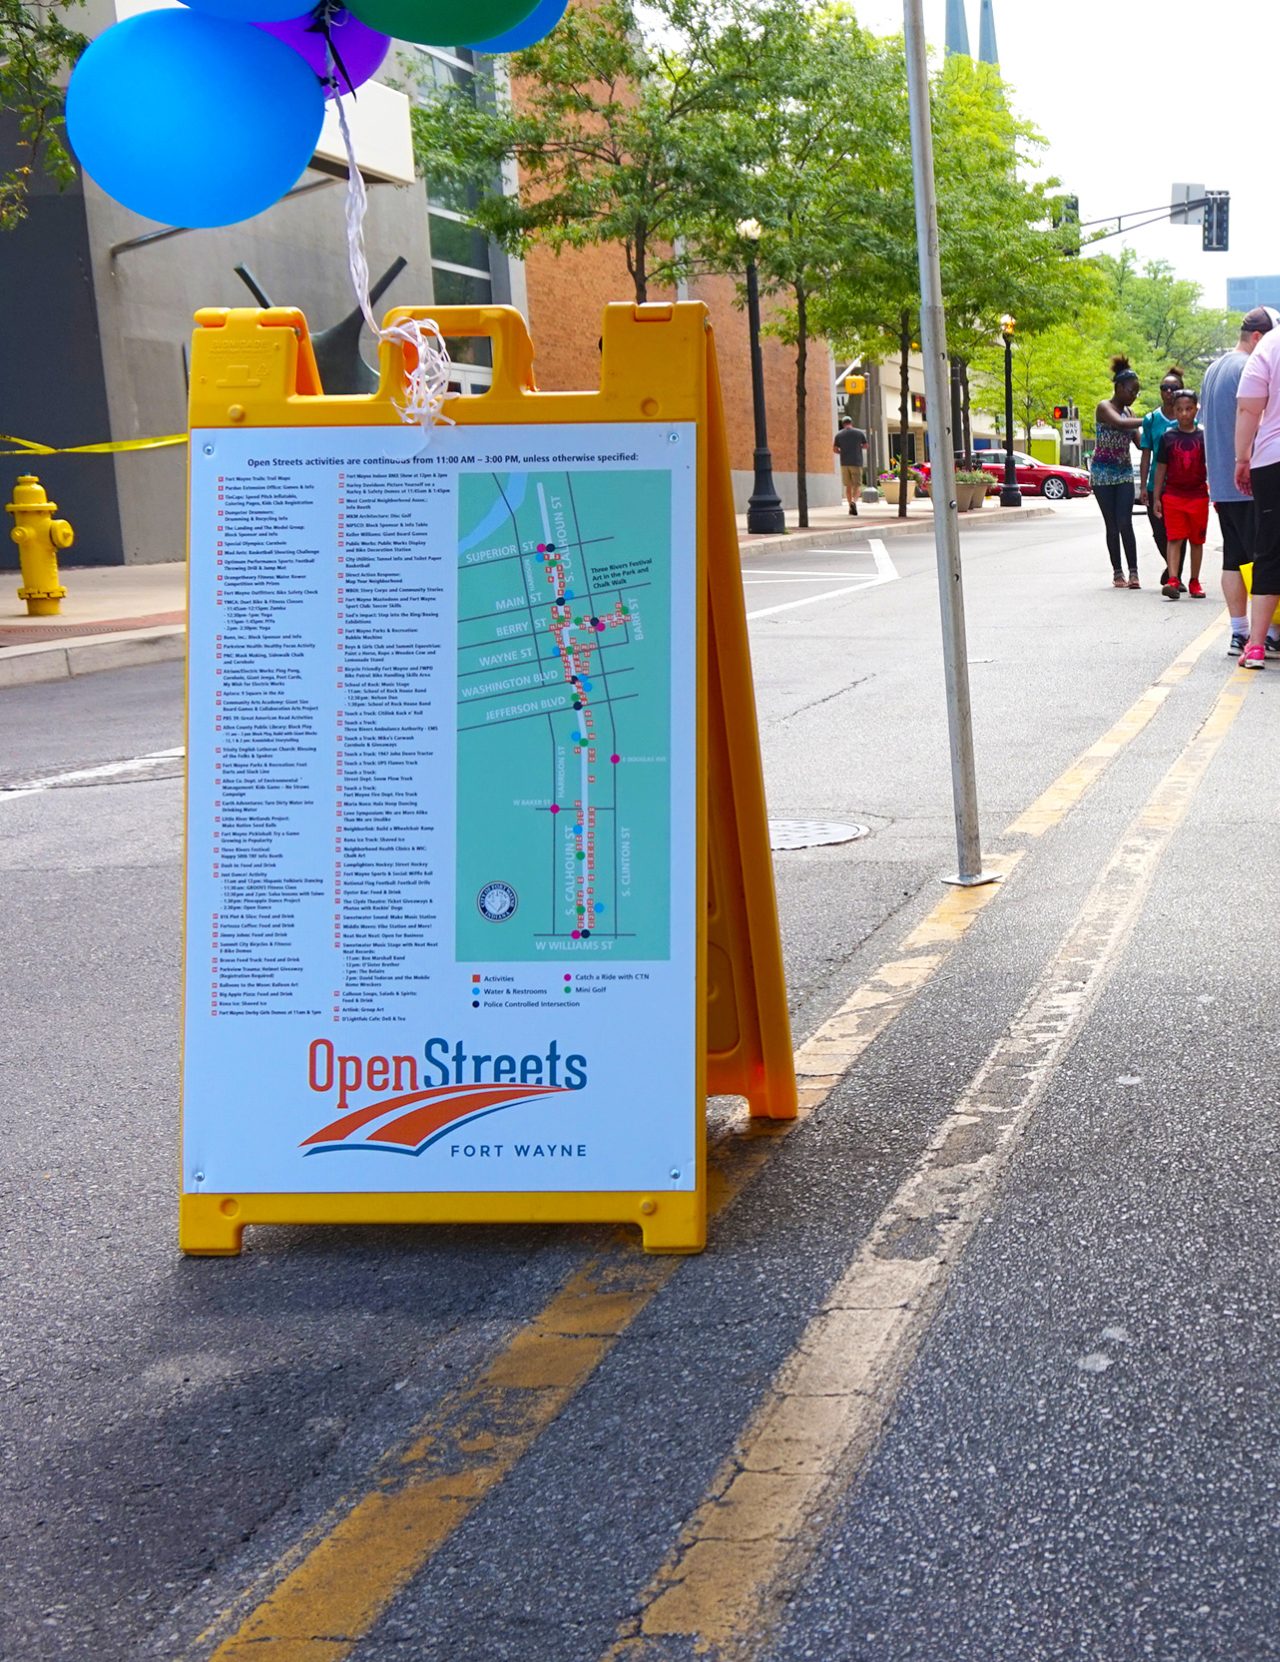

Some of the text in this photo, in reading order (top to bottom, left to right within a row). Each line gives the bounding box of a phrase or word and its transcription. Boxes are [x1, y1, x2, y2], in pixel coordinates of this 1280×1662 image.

[248, 458, 270, 467] Open
[305, 457, 344, 465] activities
[505, 455, 521, 464] PM,
[552, 454, 595, 462] otherwise
[598, 453, 639, 464] specified:
[551, 496, 562, 509] ST
[554, 512, 572, 569] CALHOUN
[466, 541, 534, 563] SUPERIOR ST
[629, 558, 652, 567] Festival
[564, 572, 574, 582] S.
[593, 581, 610, 589] Chalk
[496, 592, 542, 610] MAIN ST
[496, 622, 529, 637] BERRY
[535, 618, 547, 628] ST
[628, 598, 644, 640] BARR ST
[479, 647, 533, 666] WAYNE ST
[462, 670, 558, 698] WASHINGTON BLVD
[486, 696, 566, 720] JEFFERSON BLVD
[558, 746, 565, 756] ST
[565, 826, 575, 916] S. CALHOUN ST
[622, 827, 630, 897] S. CLINTON ST
[536, 941, 613, 950] W WILLIAMS ST
[309, 1037, 587, 1109] OpenStreets
[451, 1145, 586, 1157] FORT WAYNE
